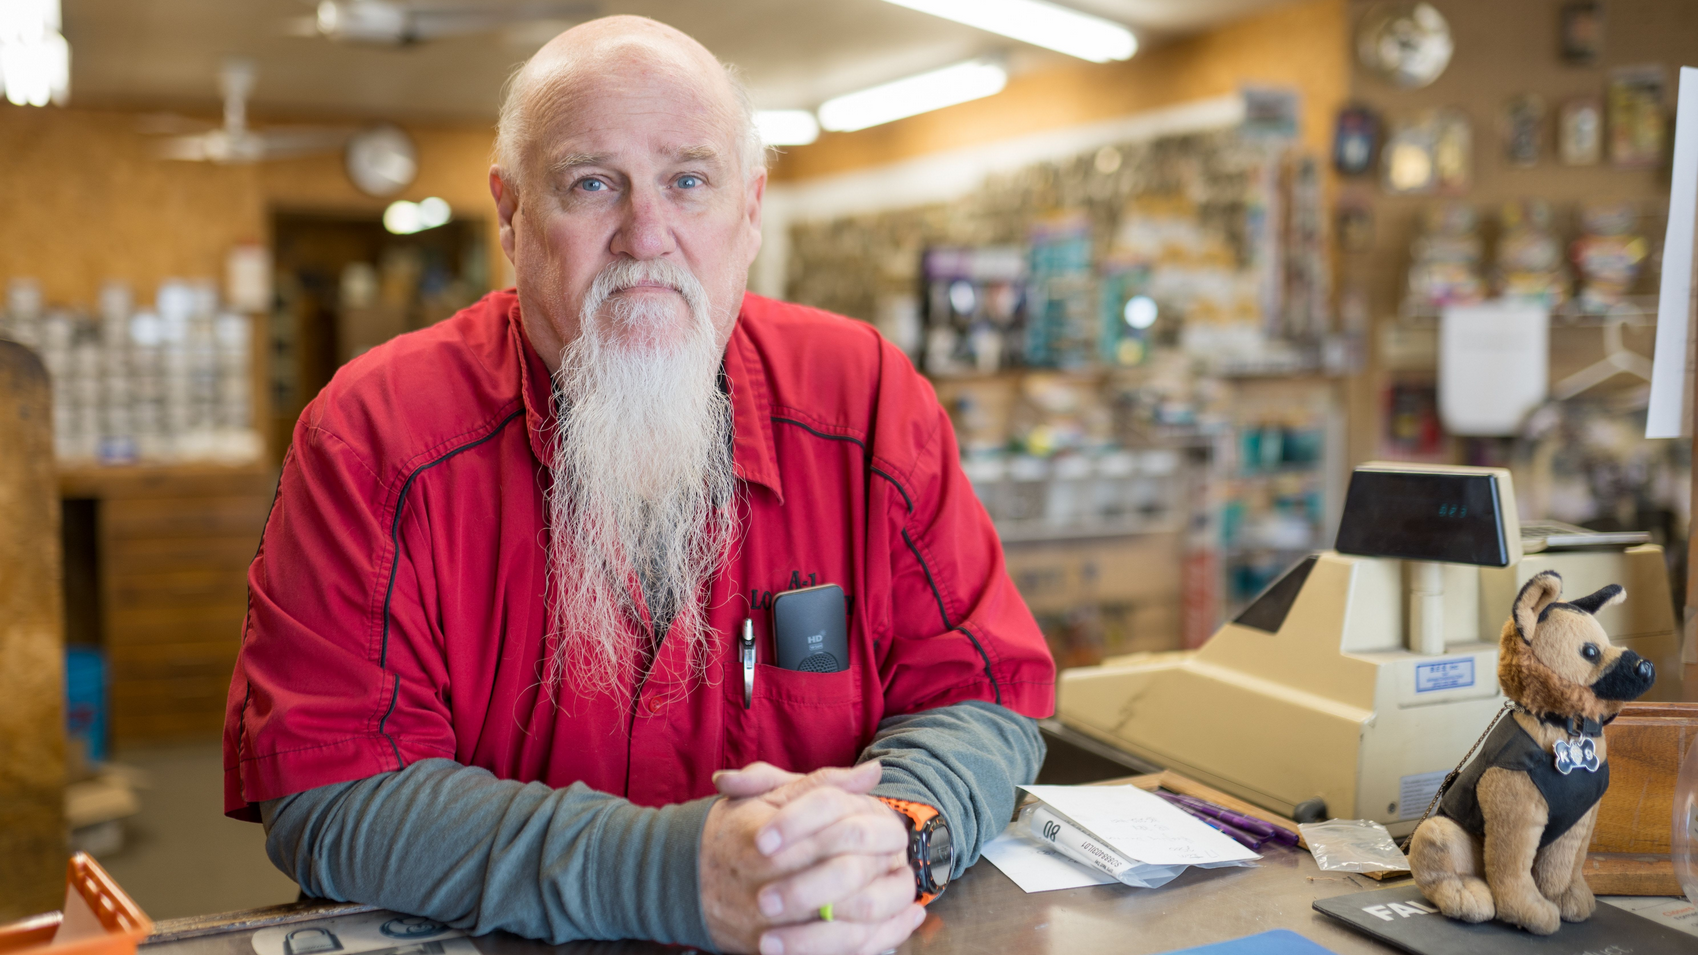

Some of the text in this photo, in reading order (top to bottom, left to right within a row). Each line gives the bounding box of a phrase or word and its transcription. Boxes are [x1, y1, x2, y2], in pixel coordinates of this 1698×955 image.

[788, 570, 816, 590] A-1
[807, 635, 823, 644] HD
[1559, 748, 1593, 763] K 9
